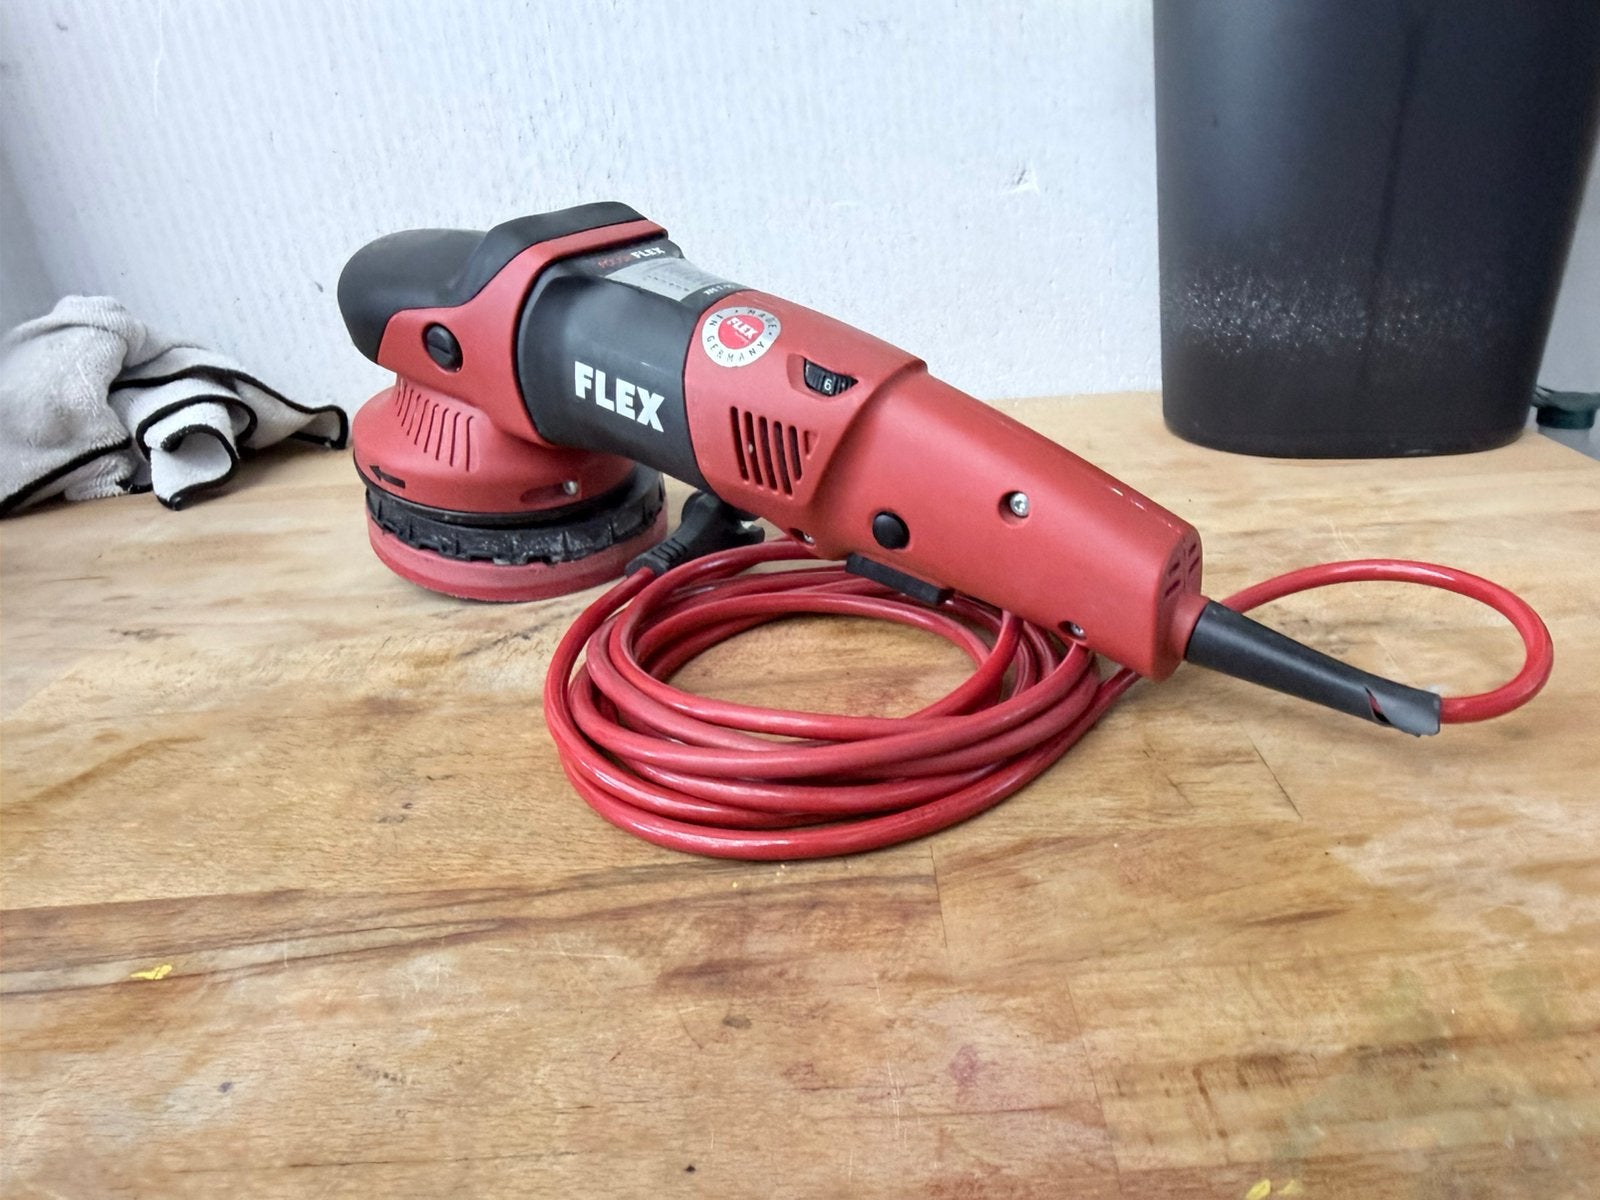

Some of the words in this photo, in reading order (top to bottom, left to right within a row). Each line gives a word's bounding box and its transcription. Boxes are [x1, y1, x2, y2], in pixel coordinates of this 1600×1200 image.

[630, 246, 666, 259] FLEX
[726, 316, 759, 340] FLEX
[574, 360, 665, 433] FLEX
